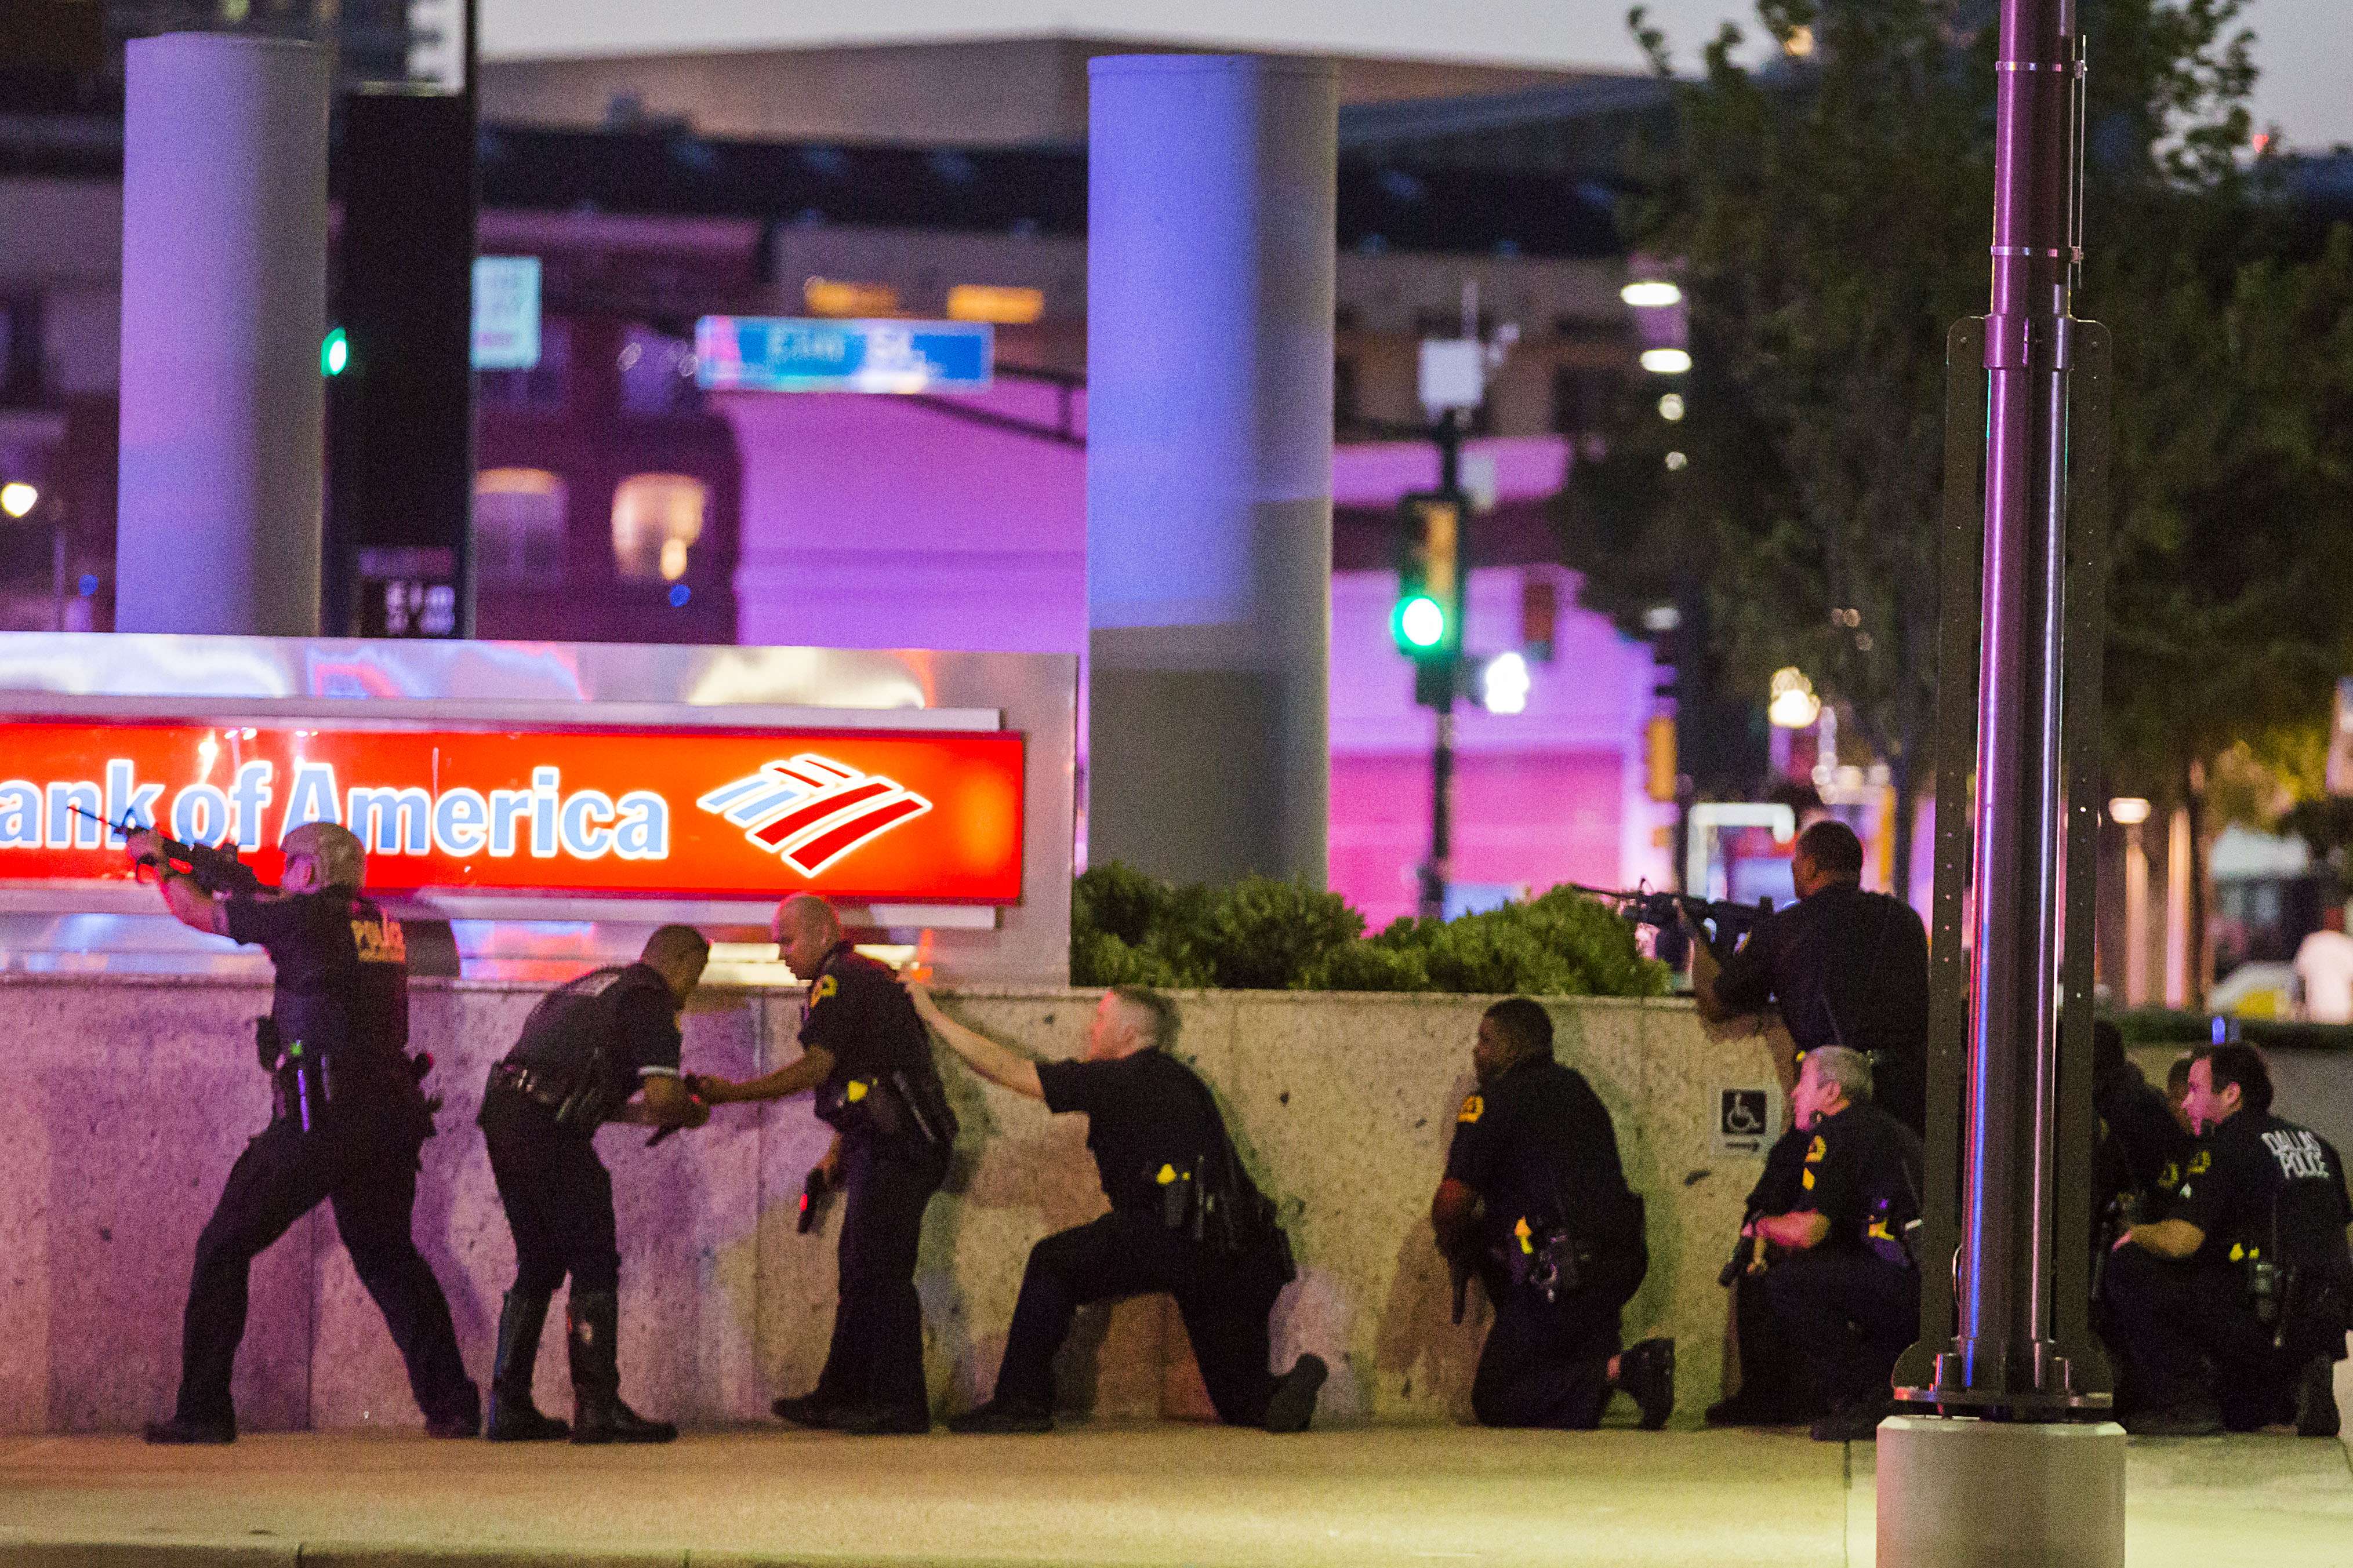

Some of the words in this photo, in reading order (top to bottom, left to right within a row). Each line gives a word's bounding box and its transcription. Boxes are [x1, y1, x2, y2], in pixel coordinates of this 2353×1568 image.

[171, 761, 273, 853] of
[279, 762, 670, 860] America
[2261, 1130, 2322, 1159] DALLAS
[2279, 1151, 2330, 1180] POLICE
